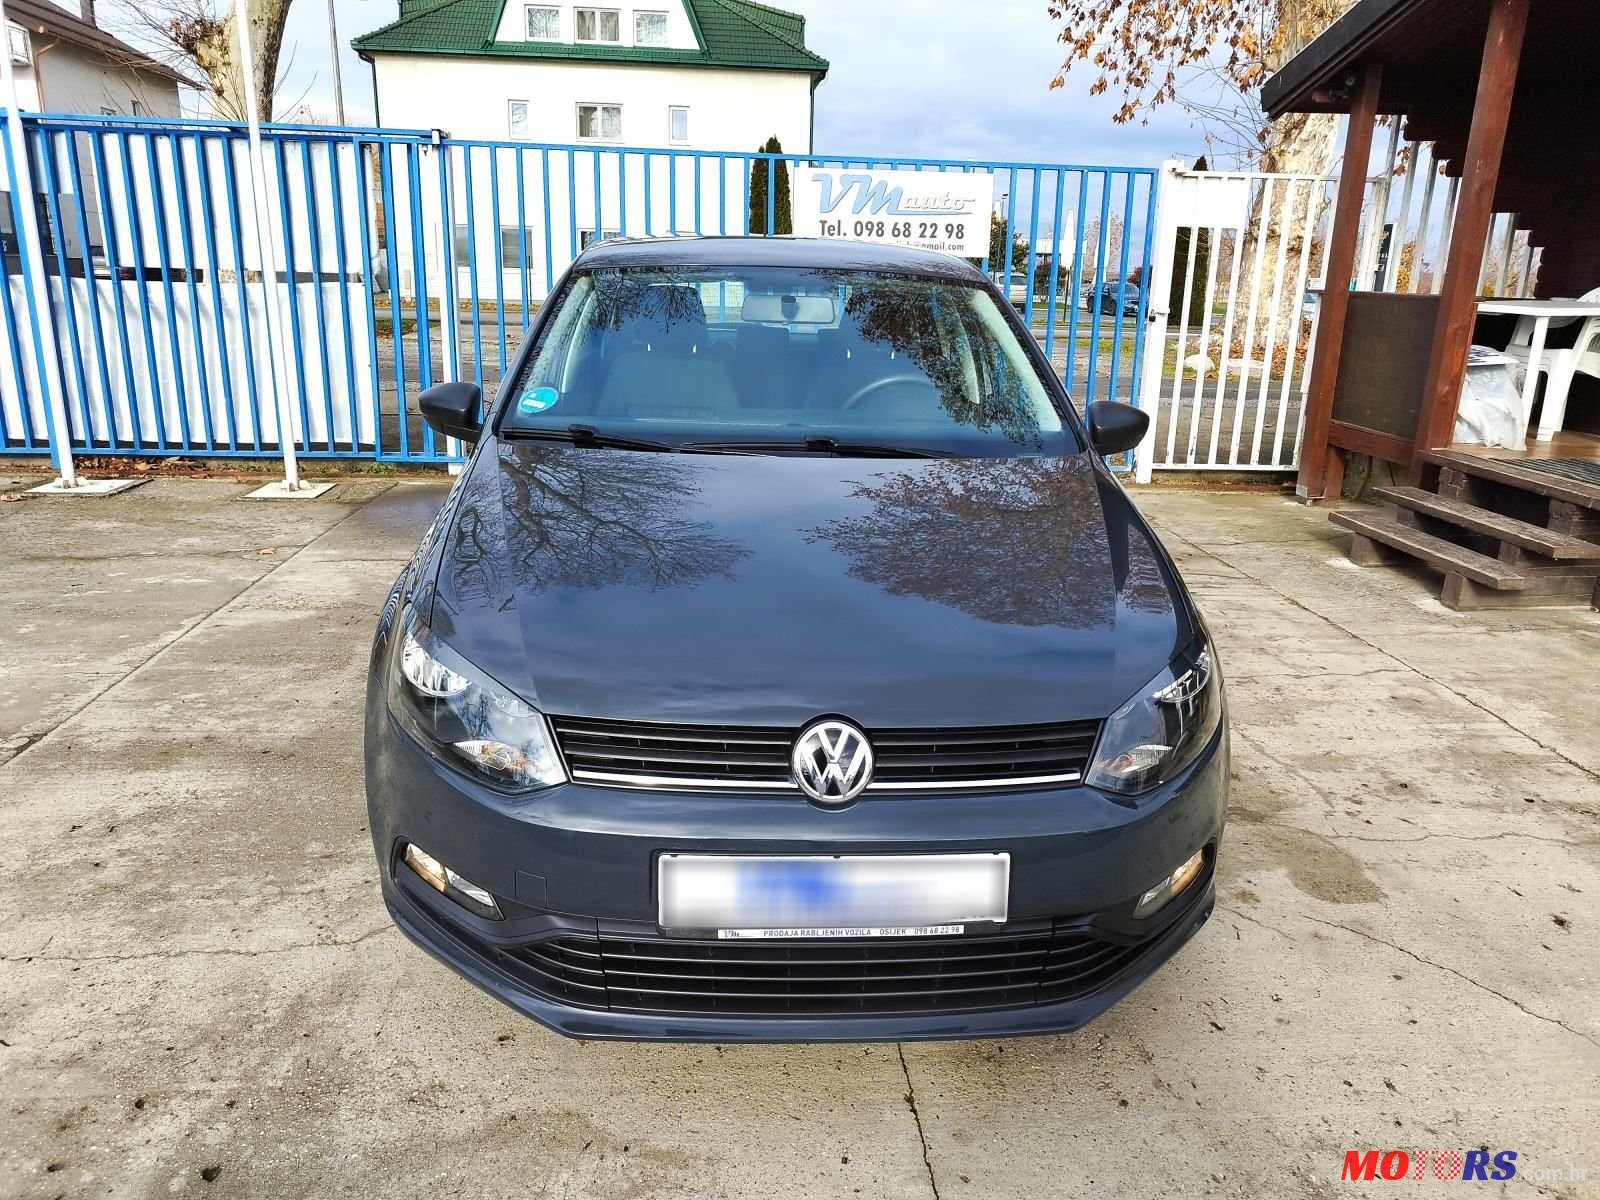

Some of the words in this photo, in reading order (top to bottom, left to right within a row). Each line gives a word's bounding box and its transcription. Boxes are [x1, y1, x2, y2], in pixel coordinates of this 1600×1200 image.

[819, 219, 847, 237] Tel.
[853, 221, 885, 238] 098
[891, 222, 912, 239] 68
[919, 223, 938, 239] 22
[945, 223, 965, 240] 98
[800, 929, 843, 937] RABLJENIH
[845, 928, 872, 936] VOZILA
[879, 928, 907, 936] OSIJEK
[914, 927, 928, 935] 098
[929, 926, 939, 935] 68
[940, 926, 950, 934] 22
